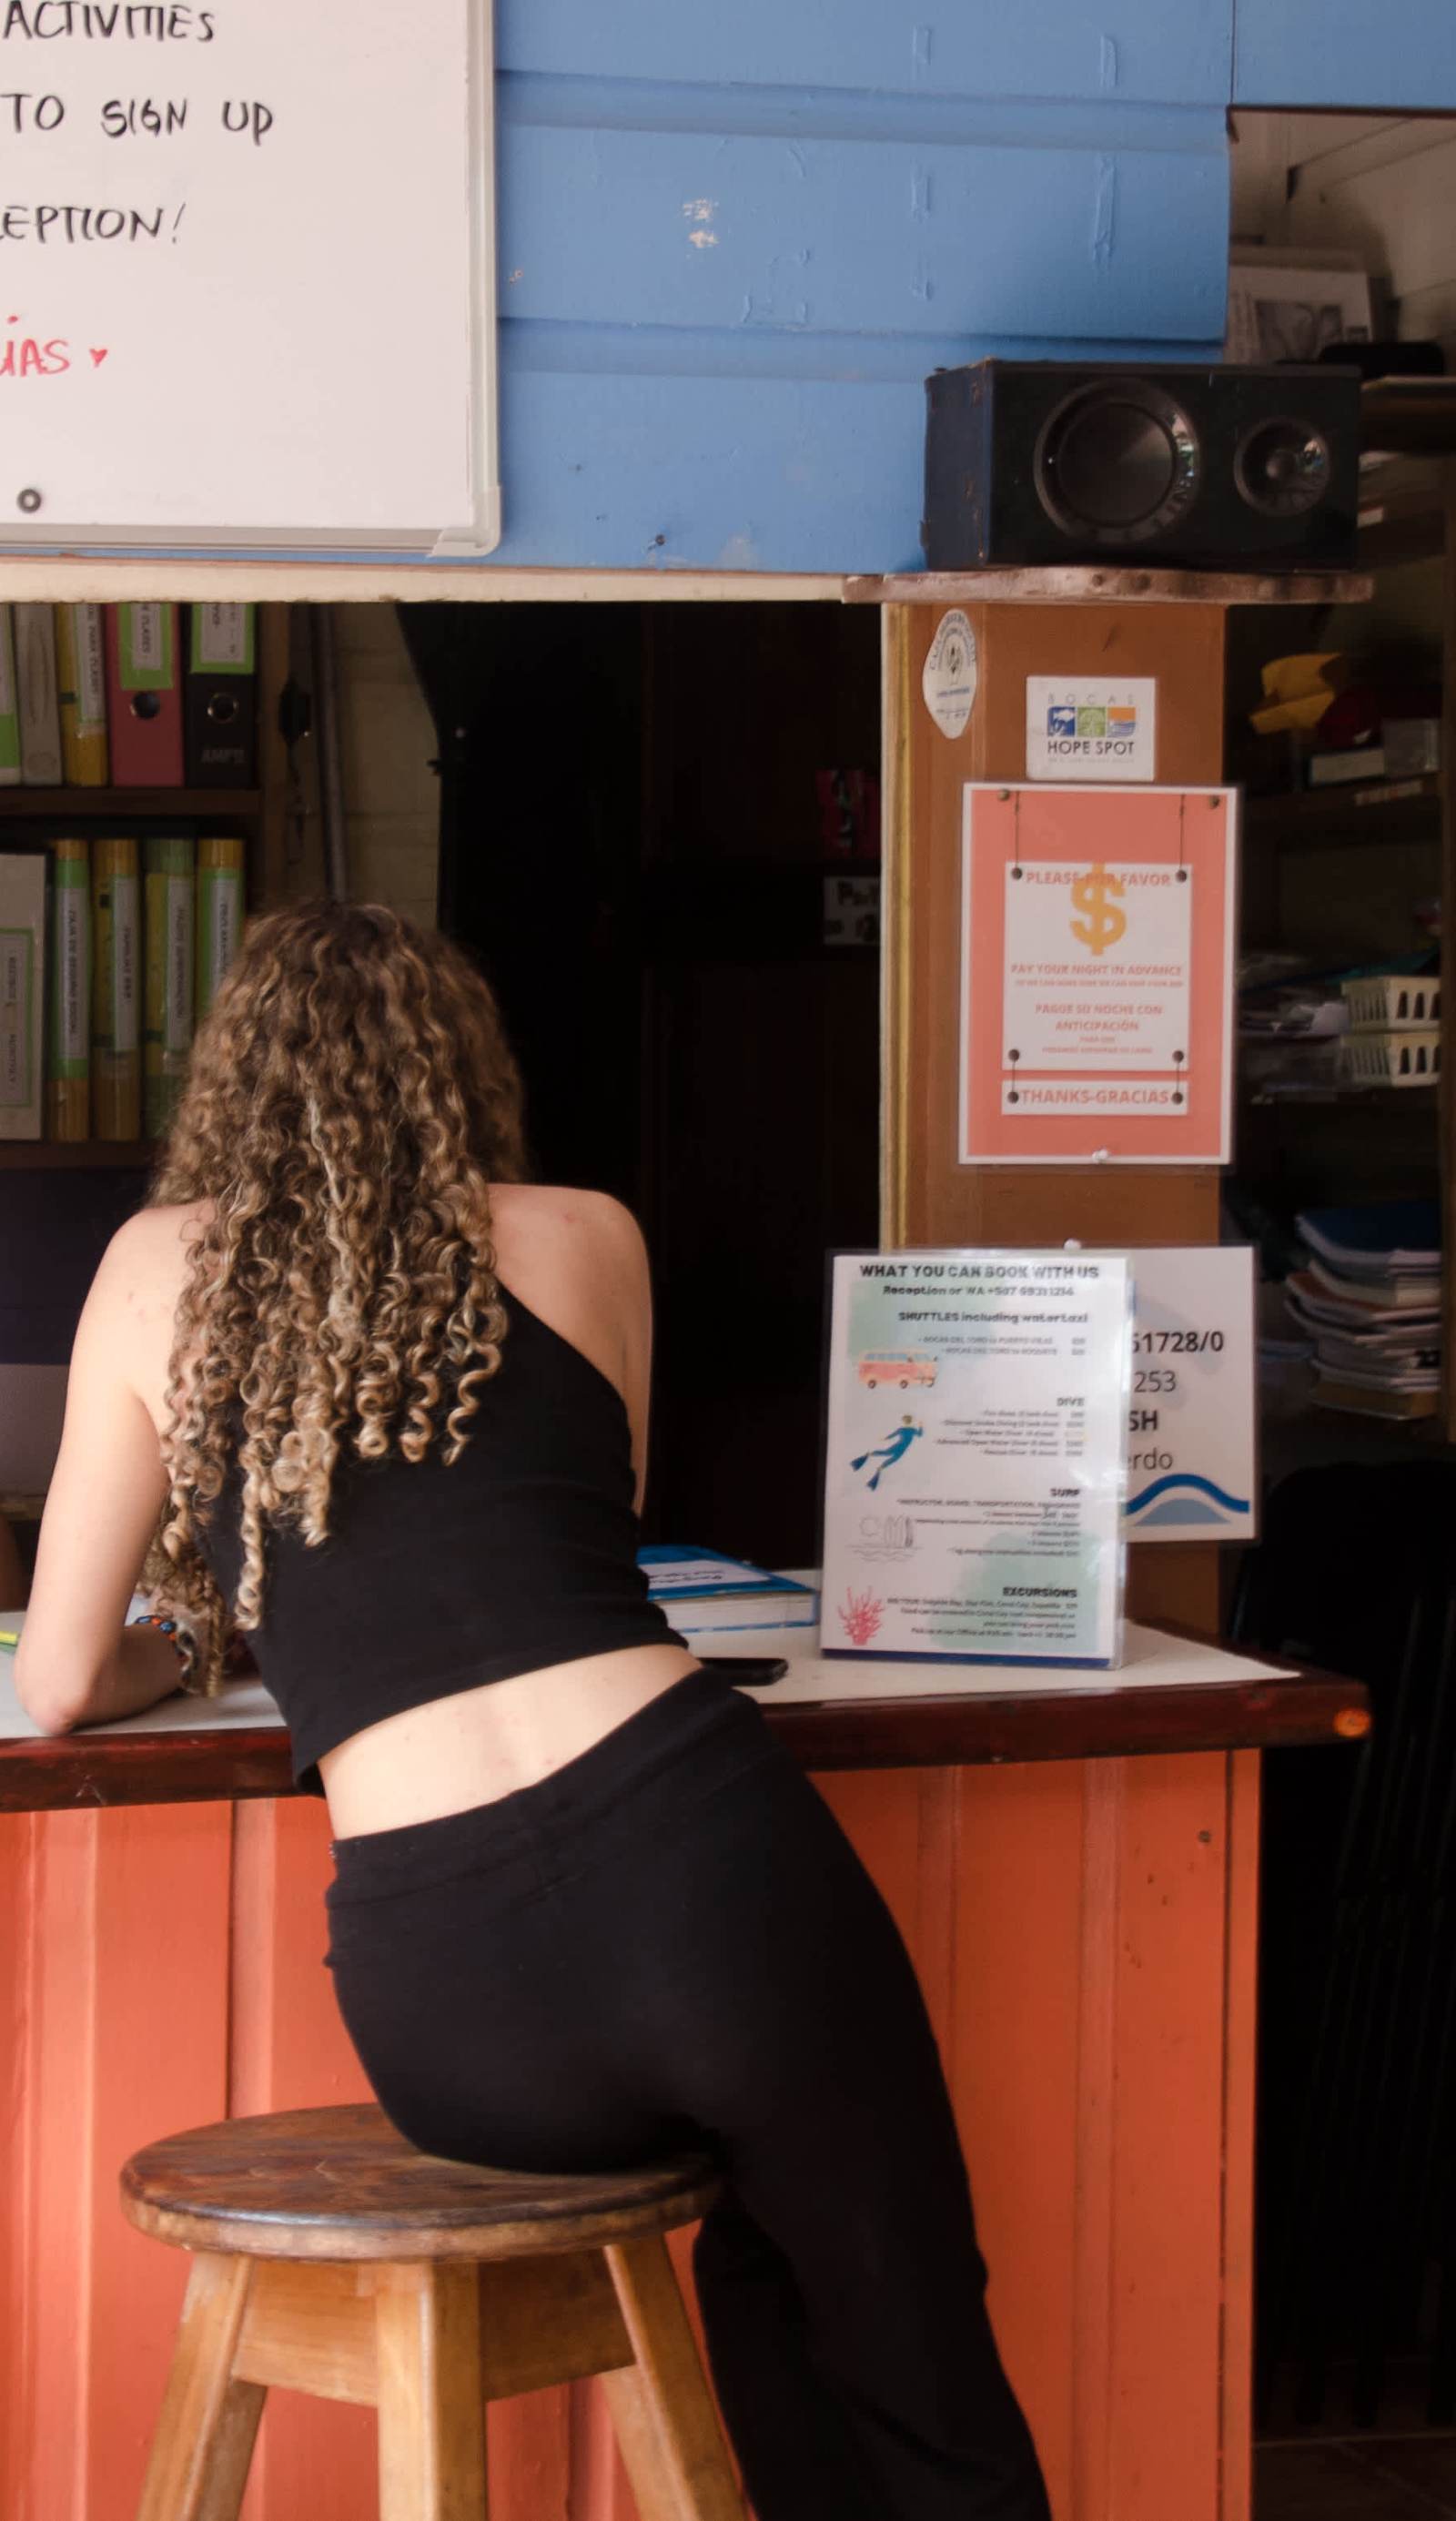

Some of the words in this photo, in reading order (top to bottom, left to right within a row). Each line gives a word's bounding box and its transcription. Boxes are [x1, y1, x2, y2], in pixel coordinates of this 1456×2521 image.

[3, 0, 214, 42] ACTIVITIES
[0, 93, 65, 133] TO
[101, 98, 187, 137] SIGN
[221, 101, 273, 146] UP
[0, 202, 187, 244] EPTION!
[1047, 740, 1090, 755] HOPE
[1095, 740, 1135, 755] SPOT
[1119, 873, 1171, 887] FAVOR
[1011, 963, 1035, 975] PAY
[1037, 964, 1068, 976] YOUR
[1071, 964, 1108, 976] NIGHT
[1110, 965, 1125, 976] IN
[1127, 965, 1182, 977] ADVANCE
[1094, 1004, 1135, 1016] NOCHE
[1138, 1005, 1163, 1016] CON
[859, 1264, 908, 1279] WHAT
[913, 1265, 945, 1279] YOU
[947, 1265, 982, 1279] CAN
[985, 1266, 1028, 1280] BOOK
[1032, 1266, 1075, 1280] WITH
[1077, 1266, 1100, 1280] US
[882, 1285, 947, 1297] Reception
[897, 1311, 959, 1322] SHUTTLES
[961, 1311, 1019, 1325] including
[1057, 1397, 1085, 1407] DIVE
[1050, 1488, 1080, 1498] SURF
[1002, 1586, 1077, 1598] EXCURSIONS
